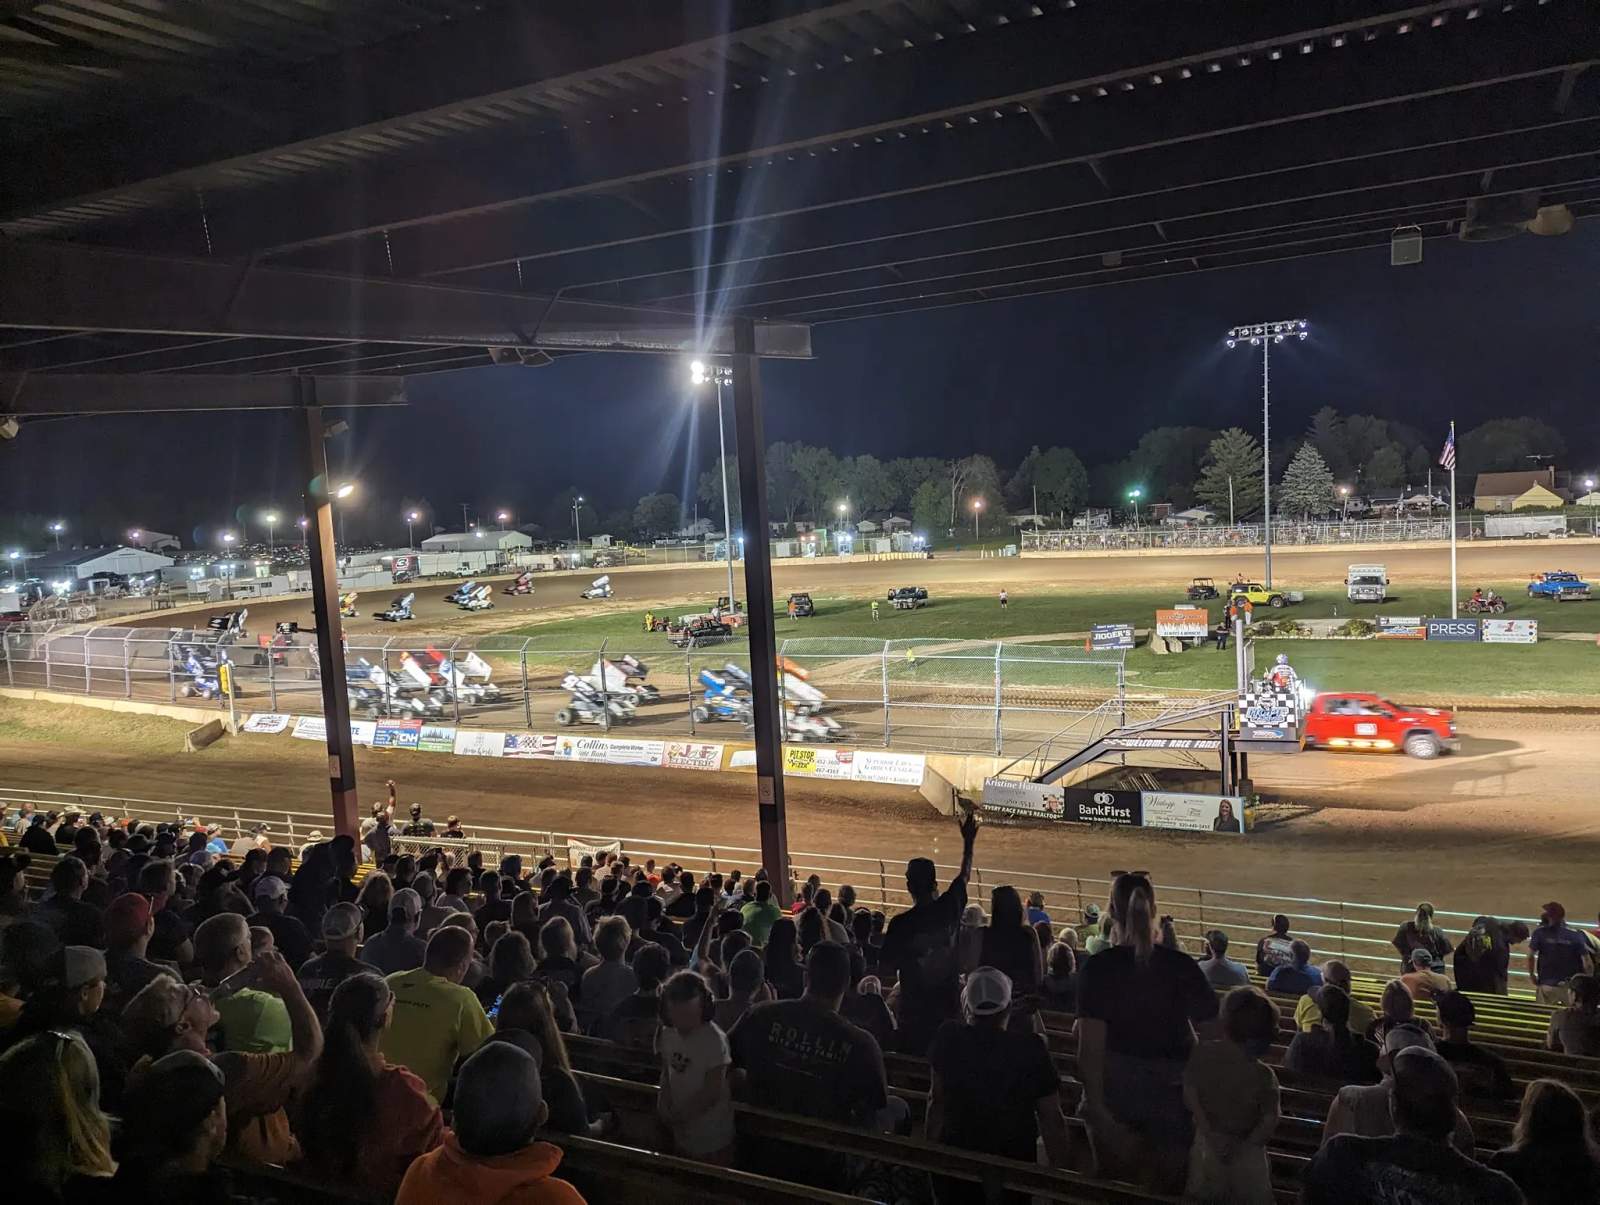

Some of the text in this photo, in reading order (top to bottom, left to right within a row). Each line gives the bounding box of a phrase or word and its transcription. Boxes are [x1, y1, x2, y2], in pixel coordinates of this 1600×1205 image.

[1430, 624, 1476, 635] PRESS
[1093, 630, 1131, 640] JIGGER'S
[577, 739, 609, 750] Collins
[1168, 740, 1192, 748] RACE
[790, 750, 814, 759] PIT STOP
[985, 778, 1017, 789] Kristine
[1002, 806, 1016, 814] RACE
[1079, 803, 1131, 817] BankFirst
